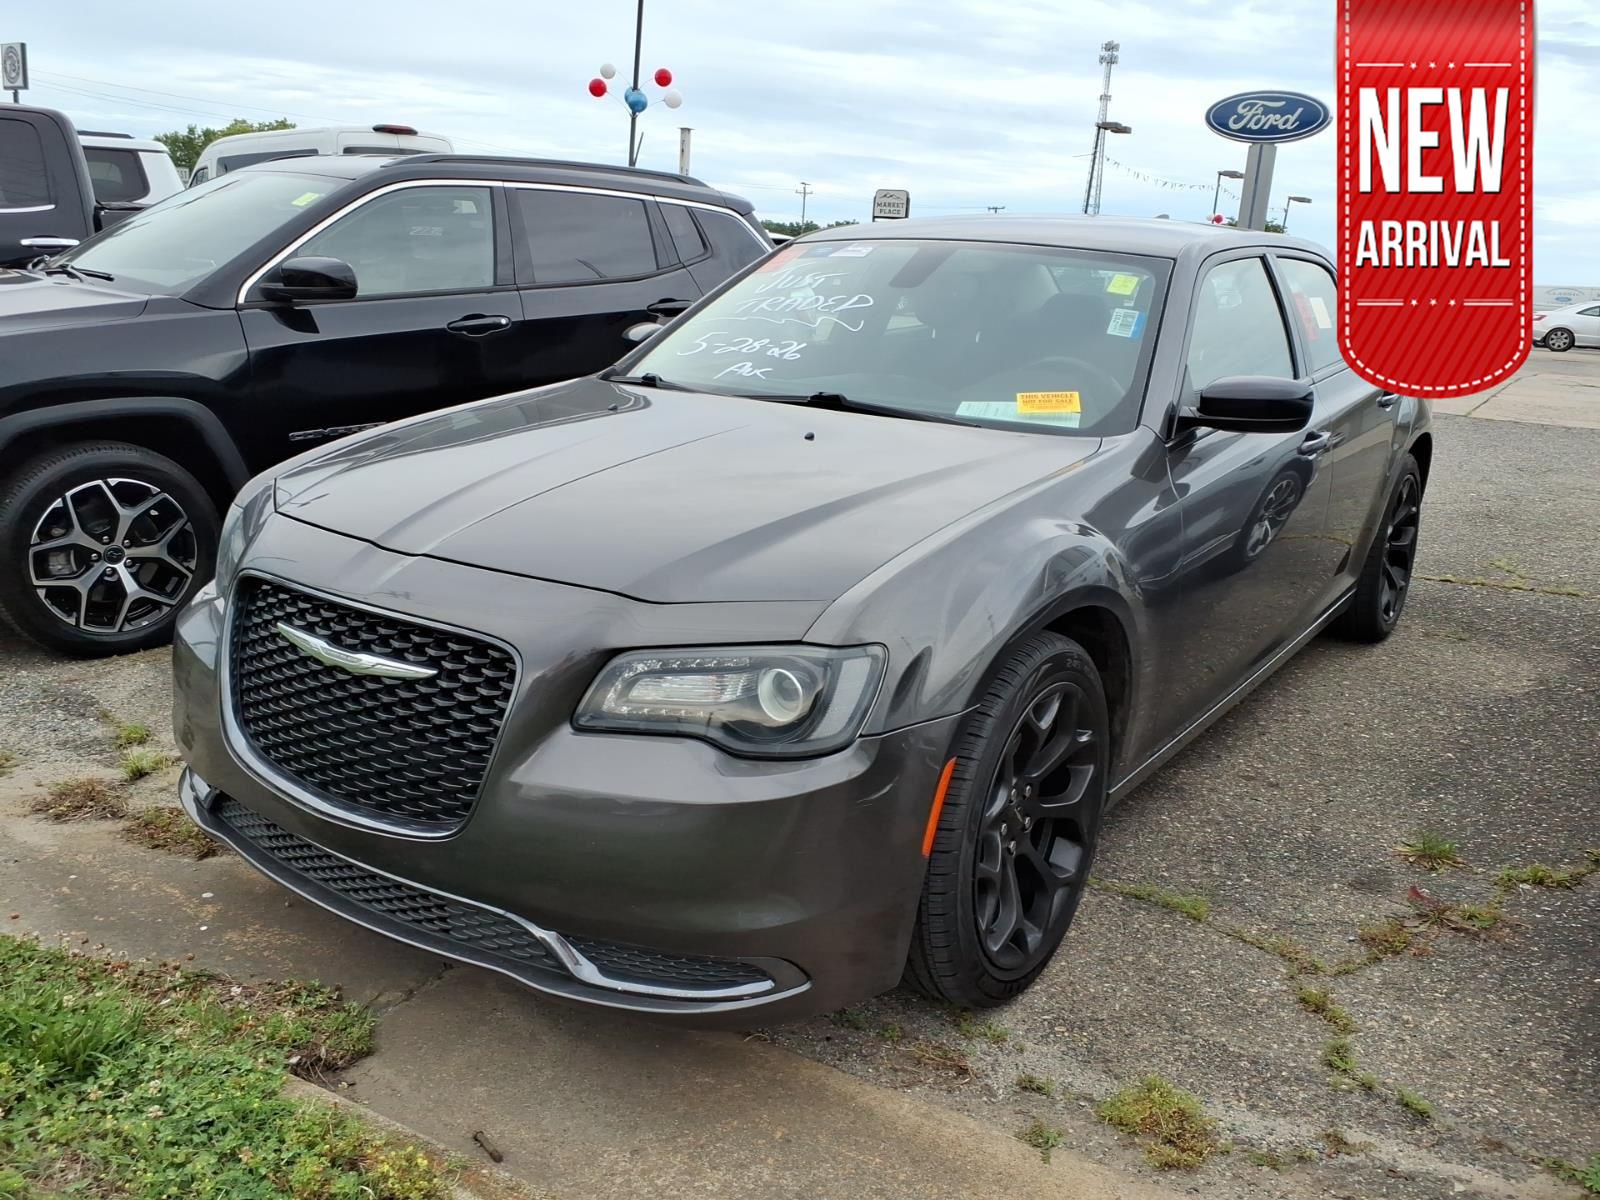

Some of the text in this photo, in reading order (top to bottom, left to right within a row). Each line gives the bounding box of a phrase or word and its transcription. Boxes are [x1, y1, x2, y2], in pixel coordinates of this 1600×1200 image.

[1228, 99, 1304, 130] Ford
[754, 261, 849, 294] JUST
[735, 294, 875, 314] TRADED
